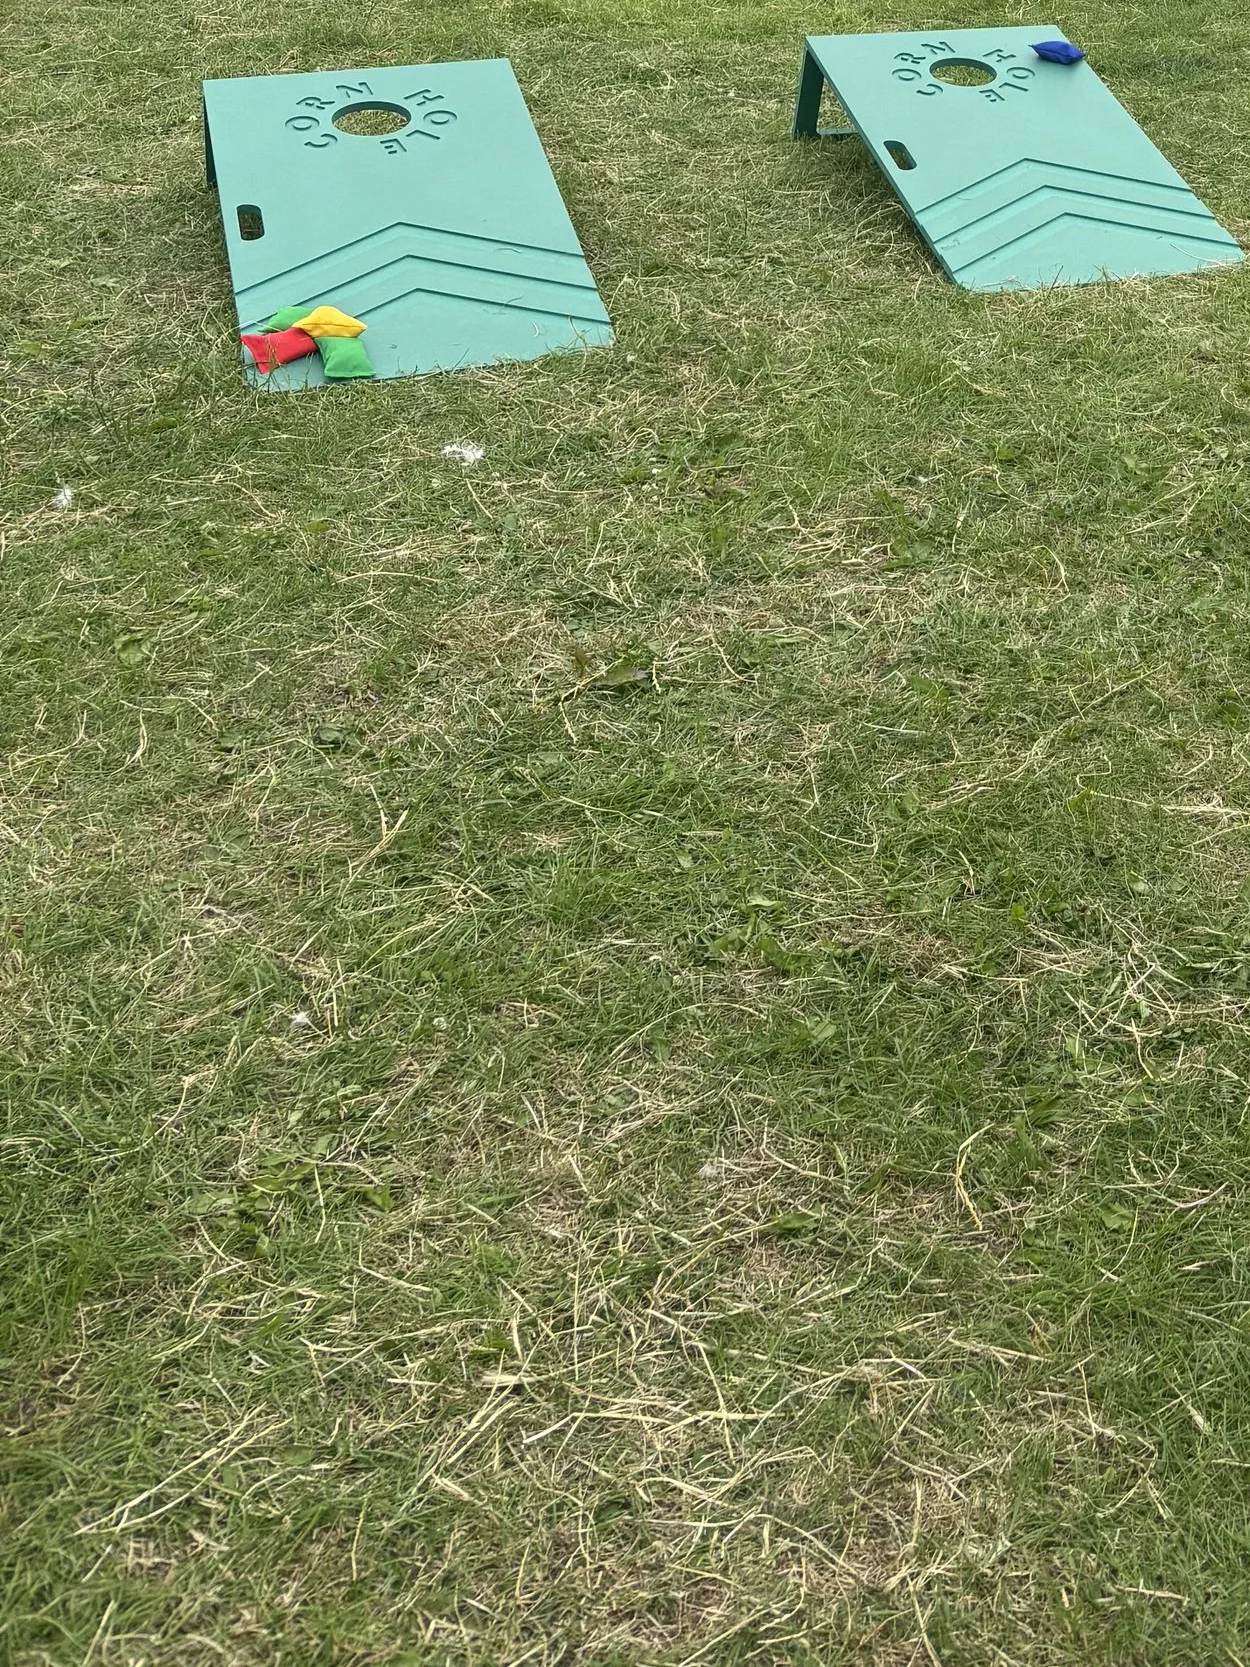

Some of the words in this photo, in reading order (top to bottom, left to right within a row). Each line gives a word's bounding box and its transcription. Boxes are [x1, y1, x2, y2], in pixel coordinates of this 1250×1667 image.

[891, 41, 956, 96] CORN
[979, 48, 1036, 103] HOLE
[284, 81, 374, 149] CORN
[379, 88, 458, 155] HOLE
